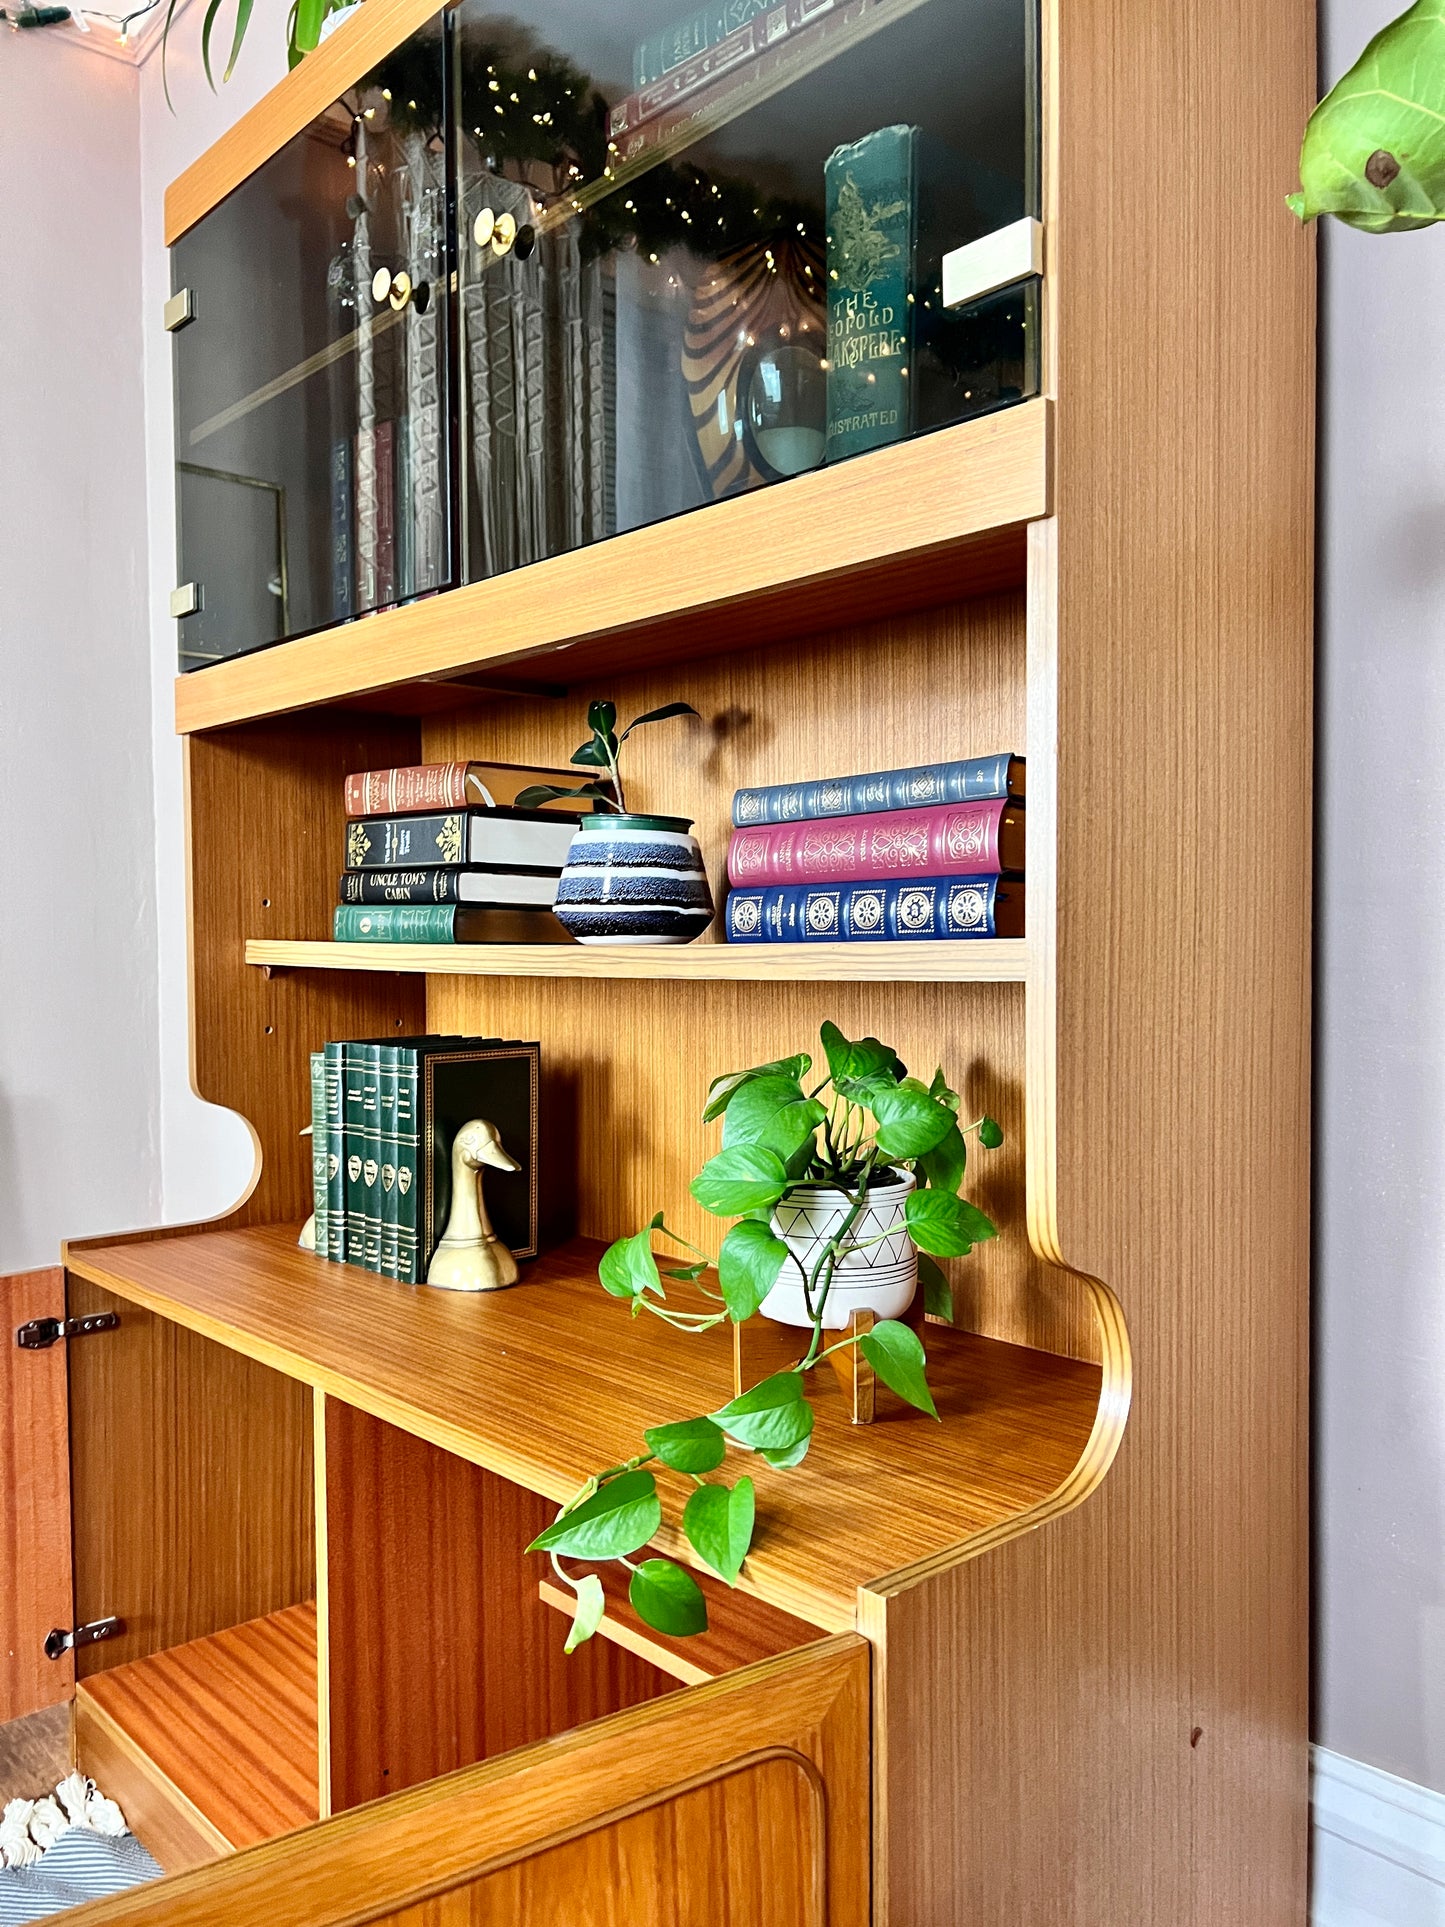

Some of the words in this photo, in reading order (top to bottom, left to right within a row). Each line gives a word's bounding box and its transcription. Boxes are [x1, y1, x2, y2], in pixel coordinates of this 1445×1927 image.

[833, 291, 878, 317] THE
[829, 306, 894, 338] OPOLD
[370, 873, 398, 887] UNCLE
[399, 871, 427, 886] TOM'S
[384, 886, 411, 900] CABIN
